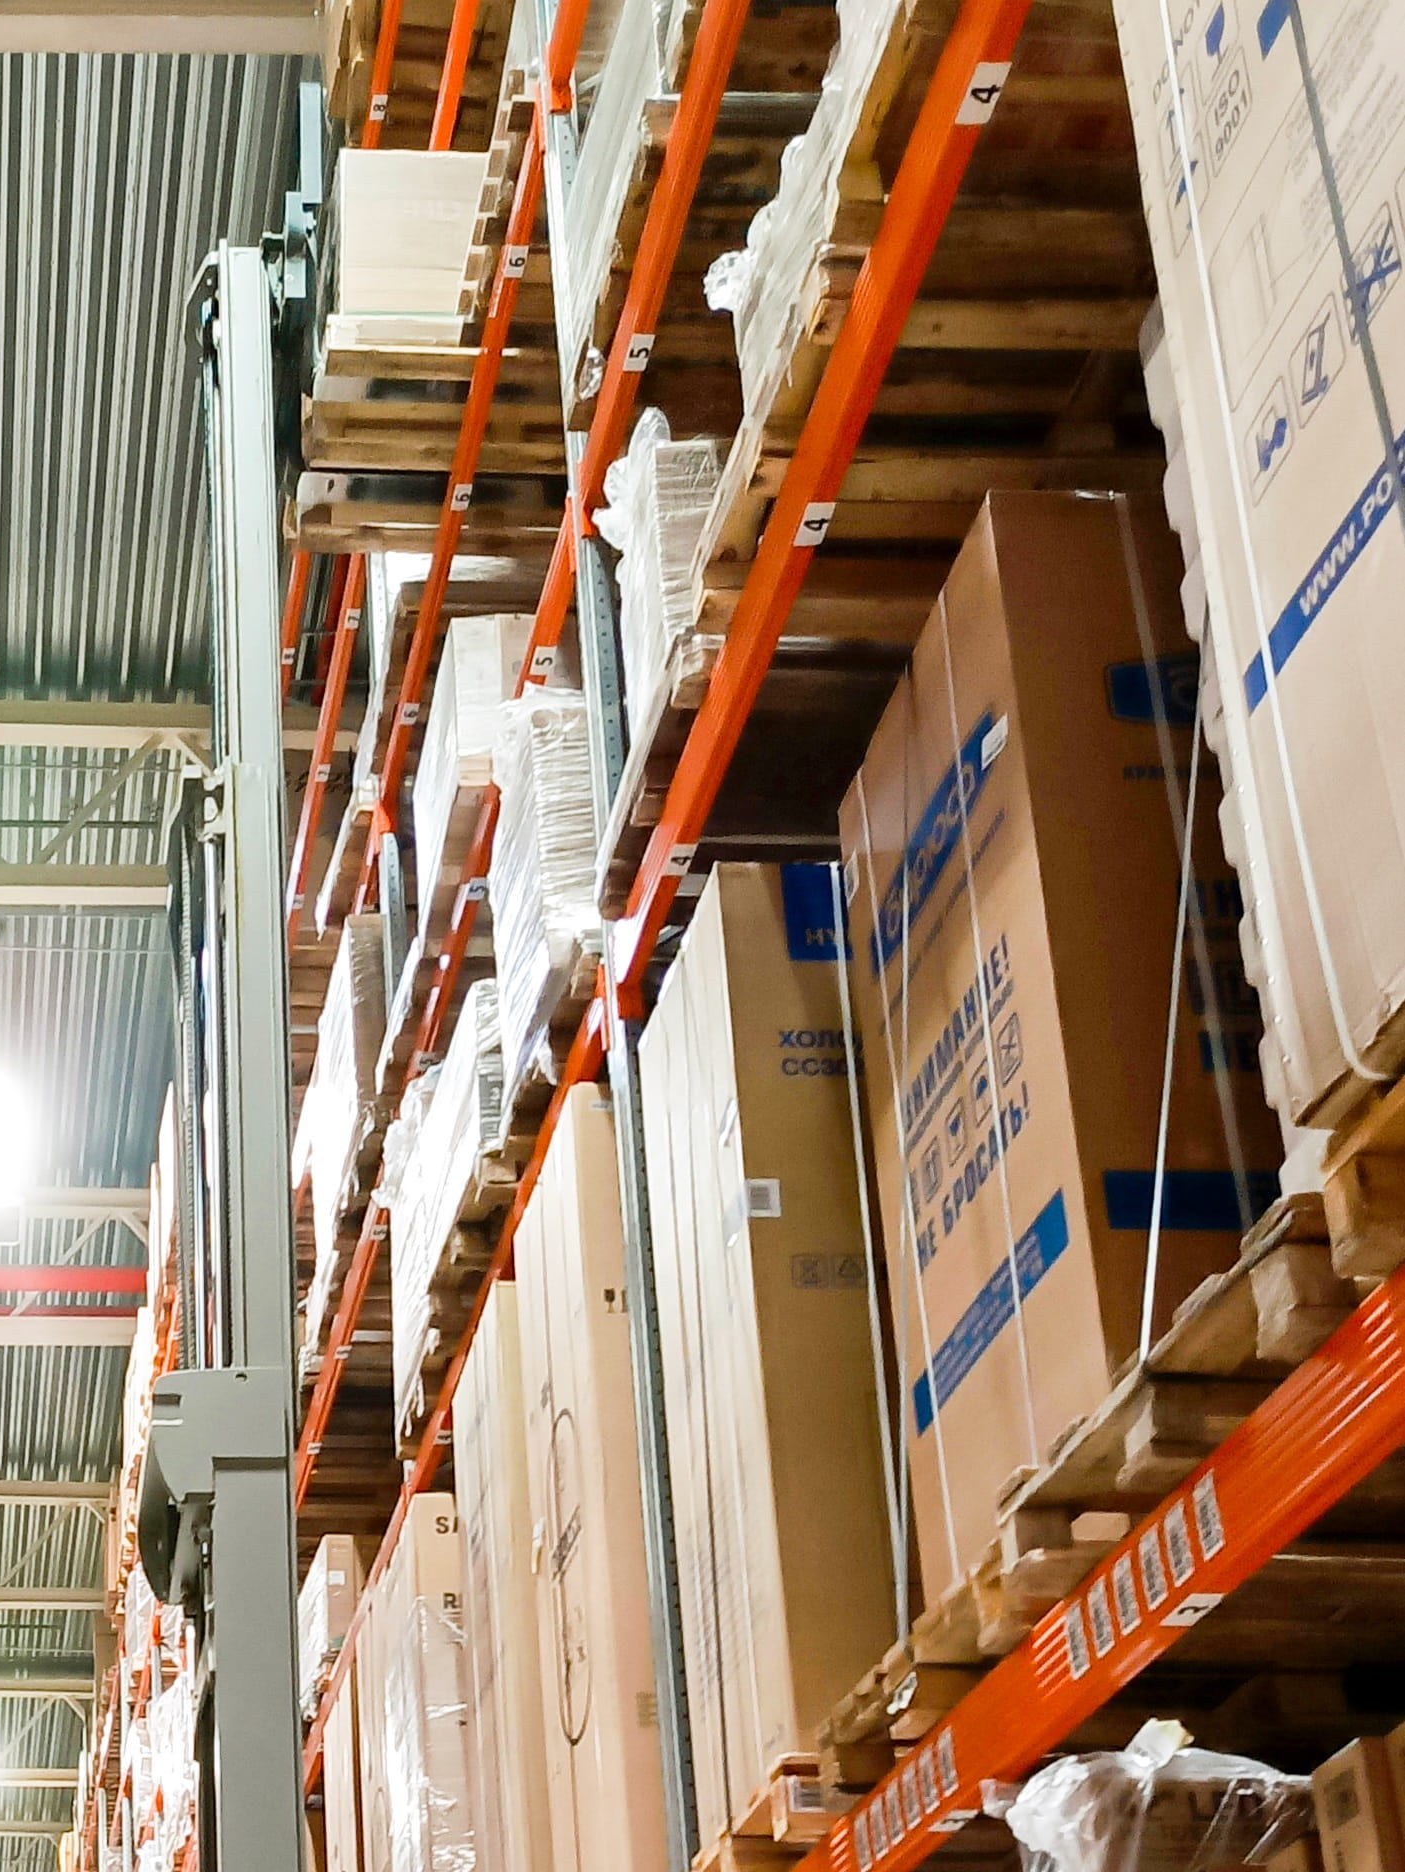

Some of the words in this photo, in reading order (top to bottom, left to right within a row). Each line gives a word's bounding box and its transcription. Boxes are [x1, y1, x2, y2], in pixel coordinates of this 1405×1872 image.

[1173, 0, 1201, 57] NO
[971, 84, 1002, 103] 4
[1214, 69, 1240, 127] ISO
[373, 103, 386, 112] 8
[1215, 88, 1248, 162] 9001
[509, 256, 525, 268] 6
[630, 347, 649, 358] 5
[455, 492, 470, 503] 6
[803, 518, 829, 531] 4
[1299, 470, 1396, 617] www.PO
[536, 657, 553, 667] 5
[671, 856, 692, 866] 4
